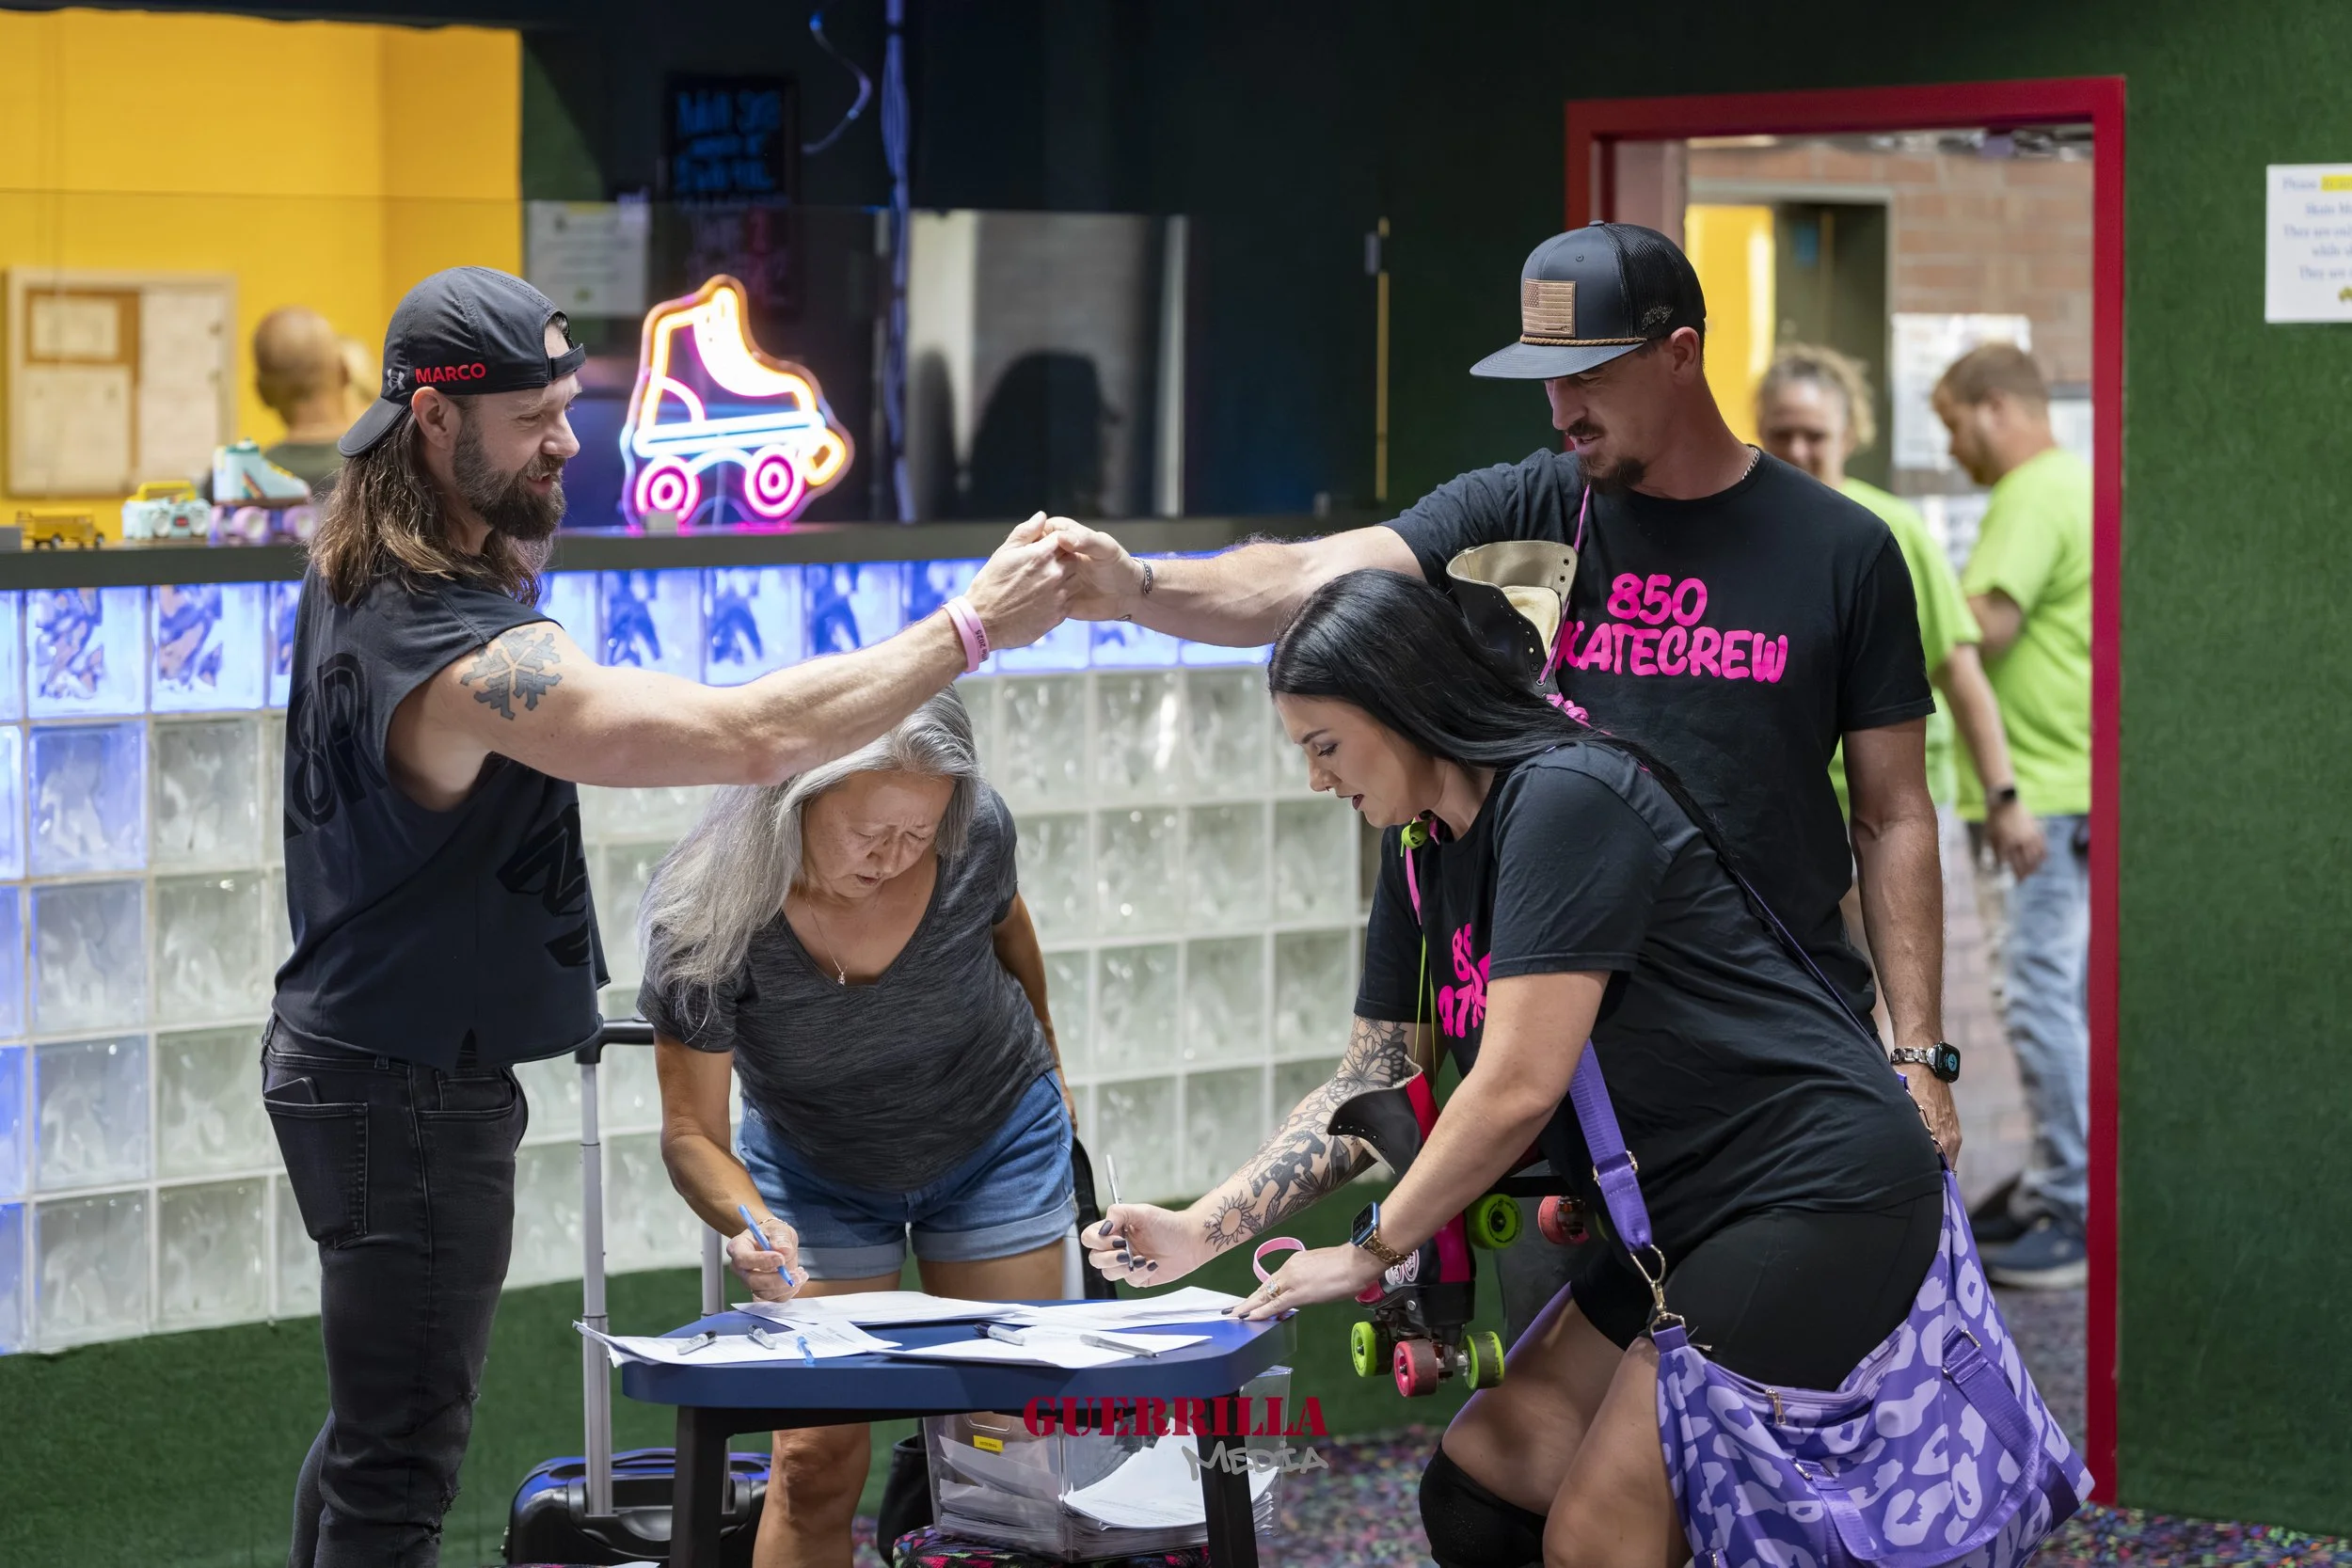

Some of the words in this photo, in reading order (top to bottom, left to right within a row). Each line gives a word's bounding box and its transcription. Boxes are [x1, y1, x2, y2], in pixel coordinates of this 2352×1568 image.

[415, 362, 486, 385] MARCO
[1607, 572, 1708, 626] 850
[1555, 621, 1788, 684] KATECREW
